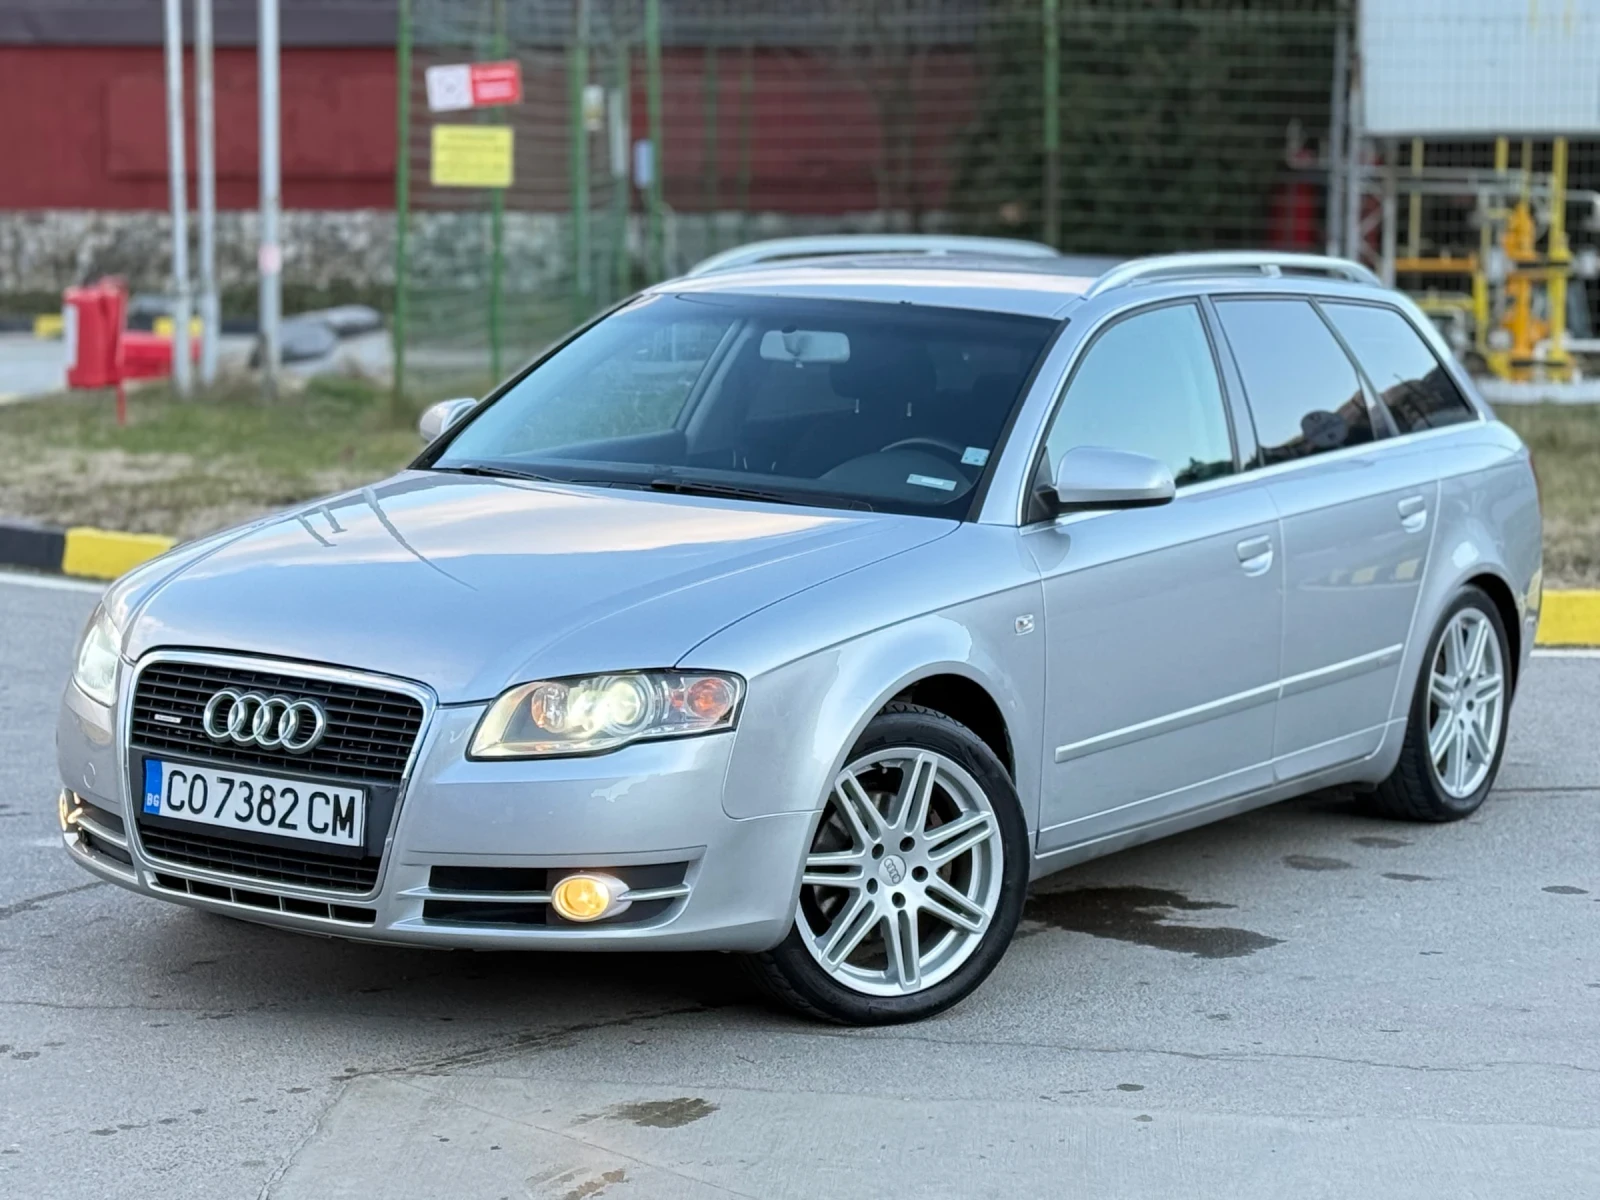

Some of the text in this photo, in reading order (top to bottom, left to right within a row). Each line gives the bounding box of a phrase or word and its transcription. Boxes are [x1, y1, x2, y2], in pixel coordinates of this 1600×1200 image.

[146, 792, 160, 807] BG
[213, 776, 299, 831] 7382
[307, 791, 356, 839] CM
